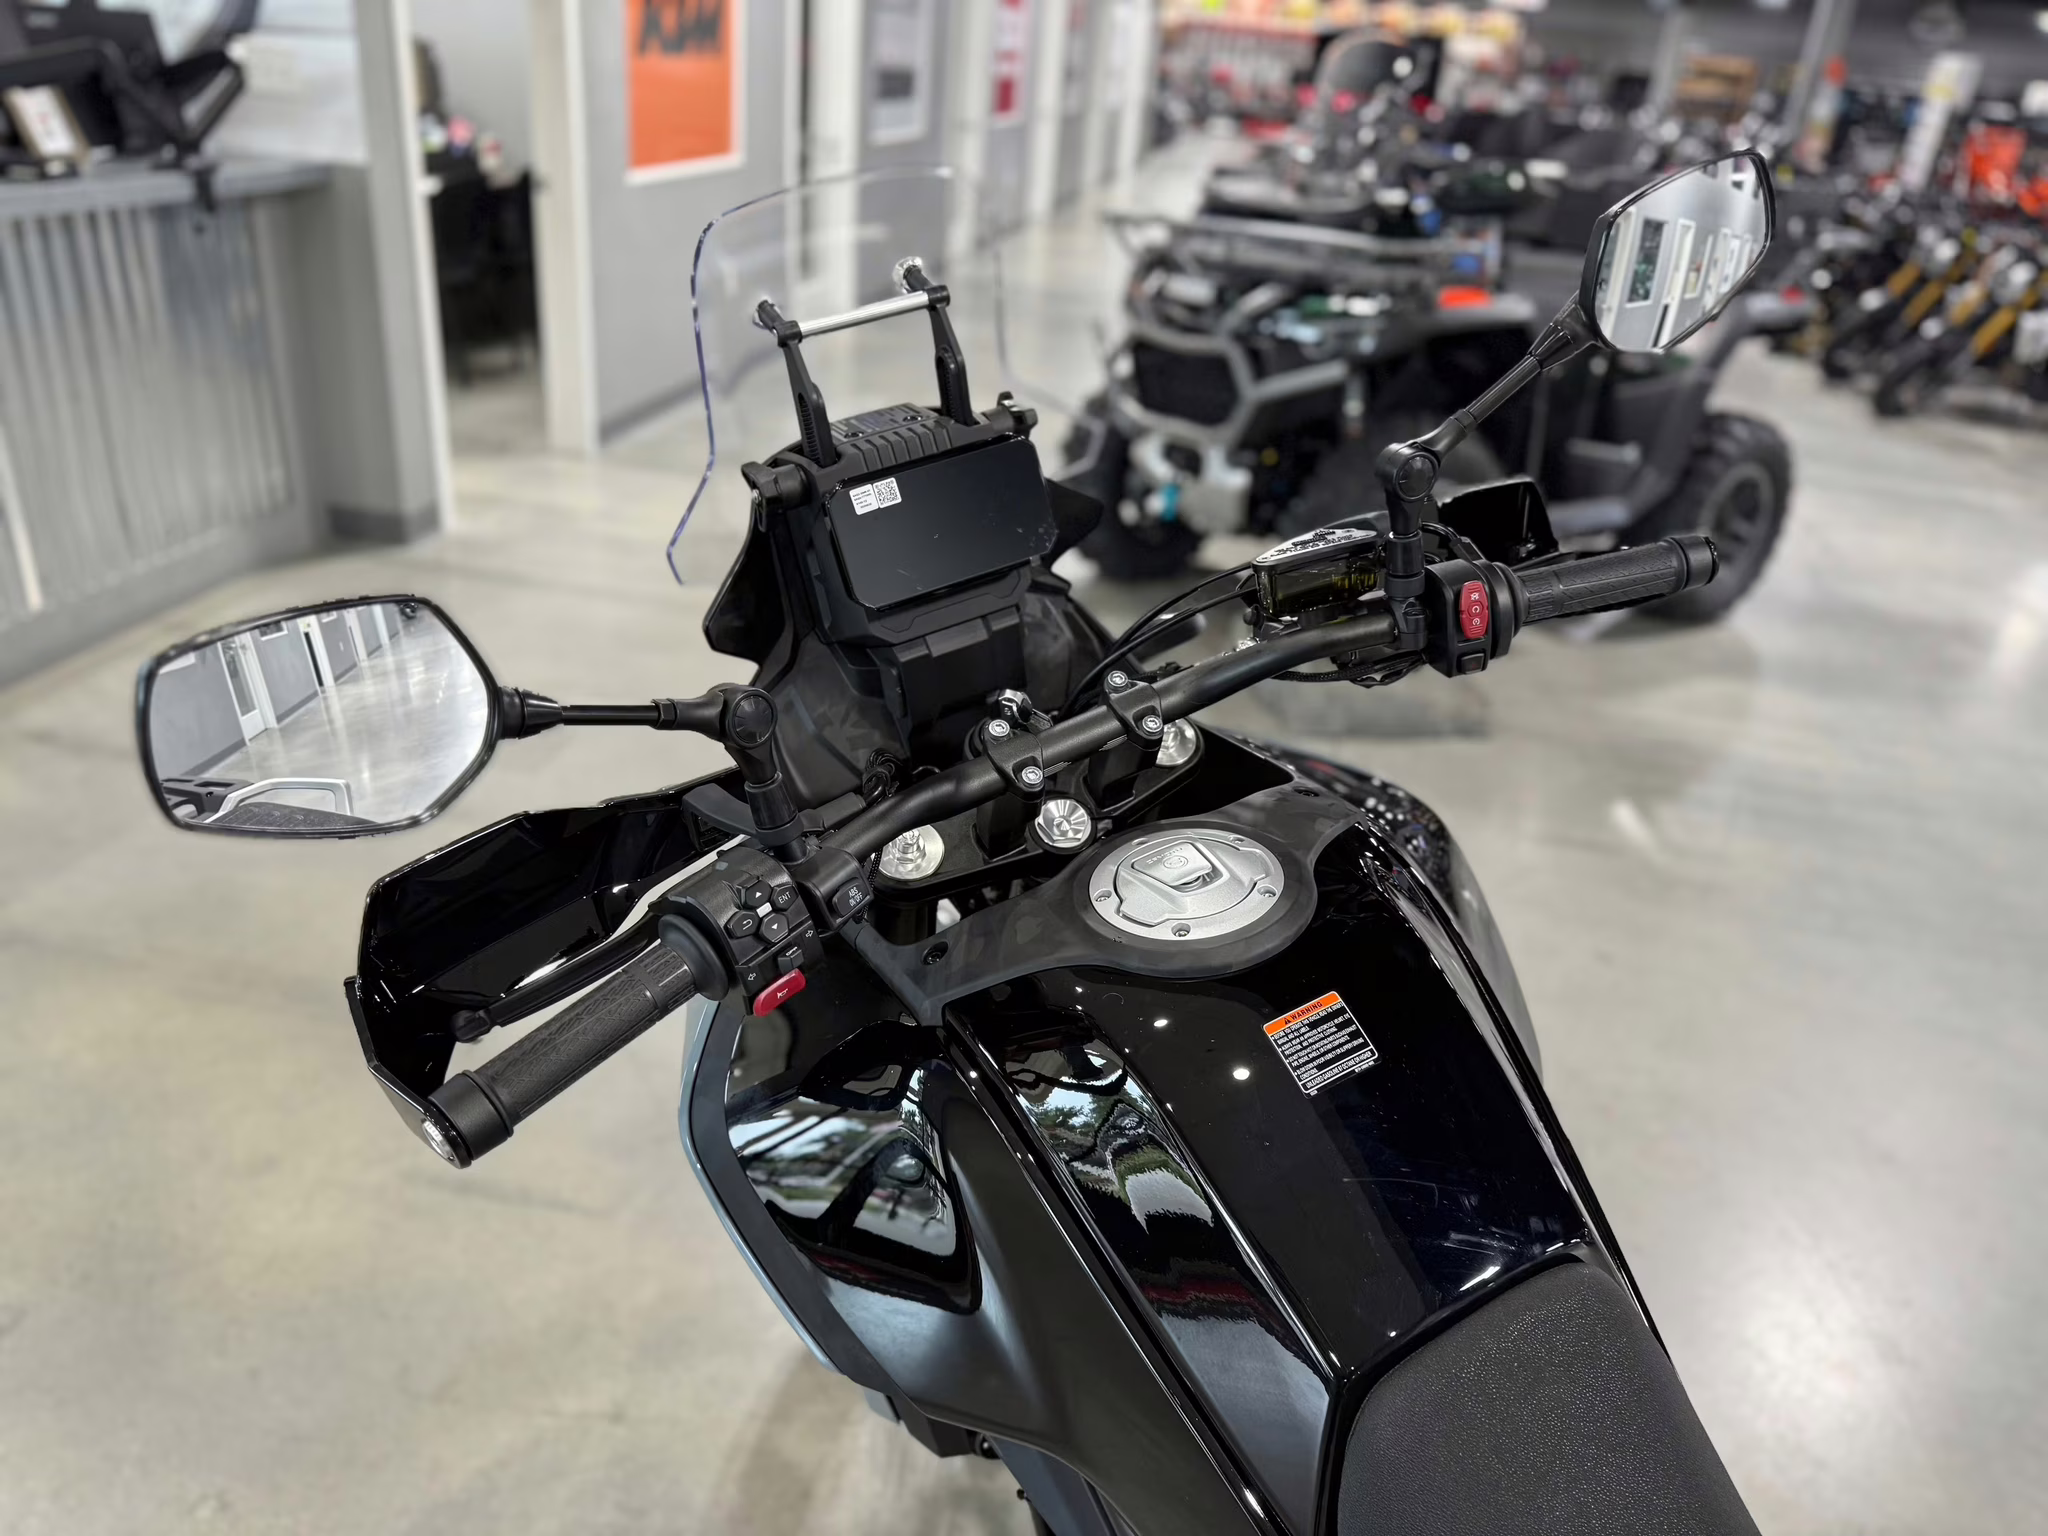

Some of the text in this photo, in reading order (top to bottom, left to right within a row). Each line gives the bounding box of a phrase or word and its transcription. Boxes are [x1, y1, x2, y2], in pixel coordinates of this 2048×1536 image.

[778, 891, 791, 904] ENT
[848, 886, 859, 898] ABS
[1290, 1001, 1323, 1020] WARNING
[1305, 1075, 1324, 1088] UNLEADED
[1323, 1068, 1340, 1079] GASOLINE
[1342, 1060, 1356, 1070] OCTANE
